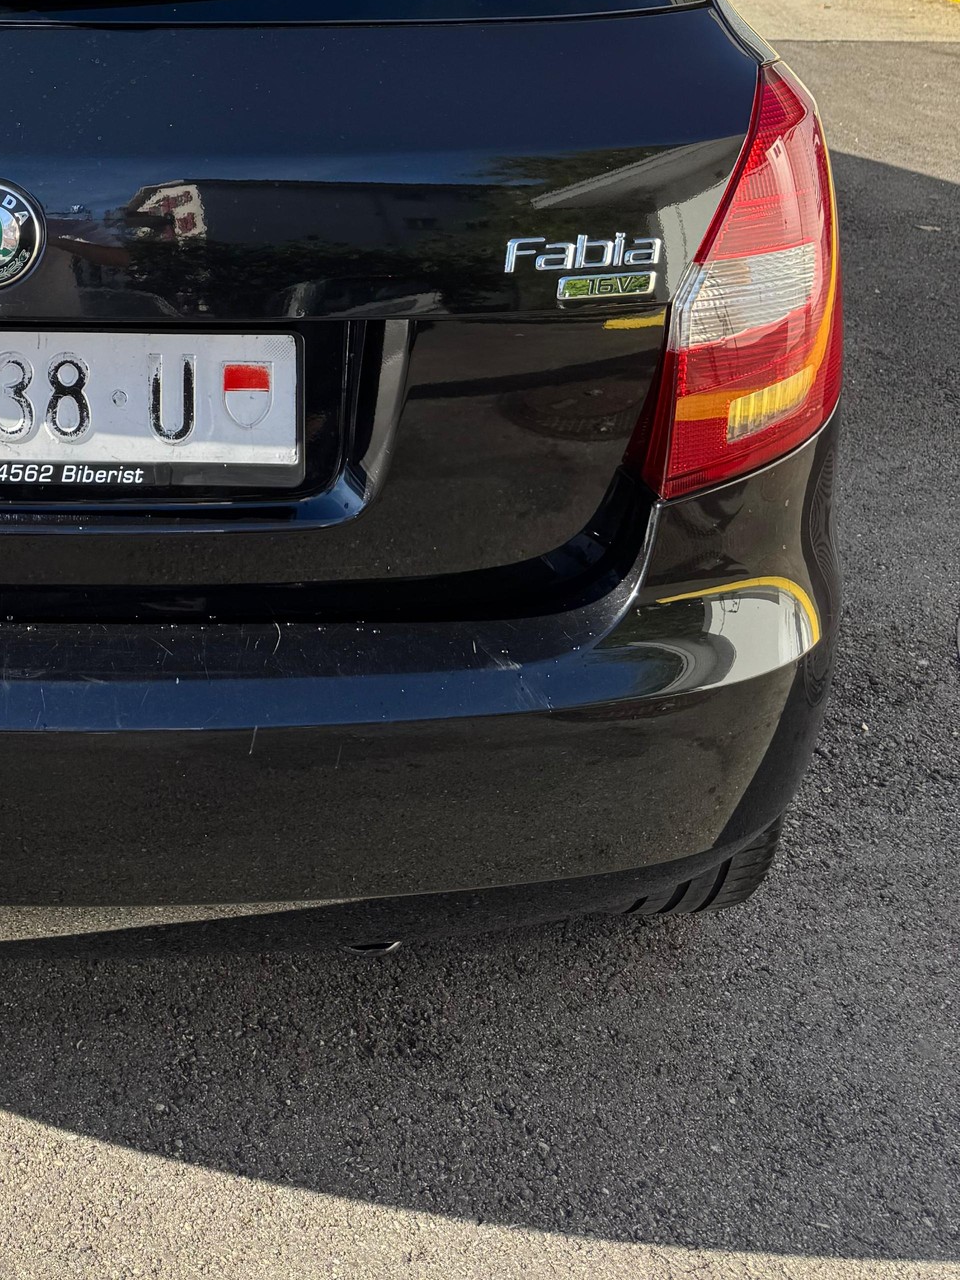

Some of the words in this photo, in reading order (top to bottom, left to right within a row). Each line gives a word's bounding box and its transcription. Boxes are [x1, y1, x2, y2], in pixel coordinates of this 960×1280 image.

[504, 232, 662, 273] Fabia
[588, 275, 634, 295] 16V
[148, 352, 197, 446] U
[61, 465, 144, 484] Biberist
